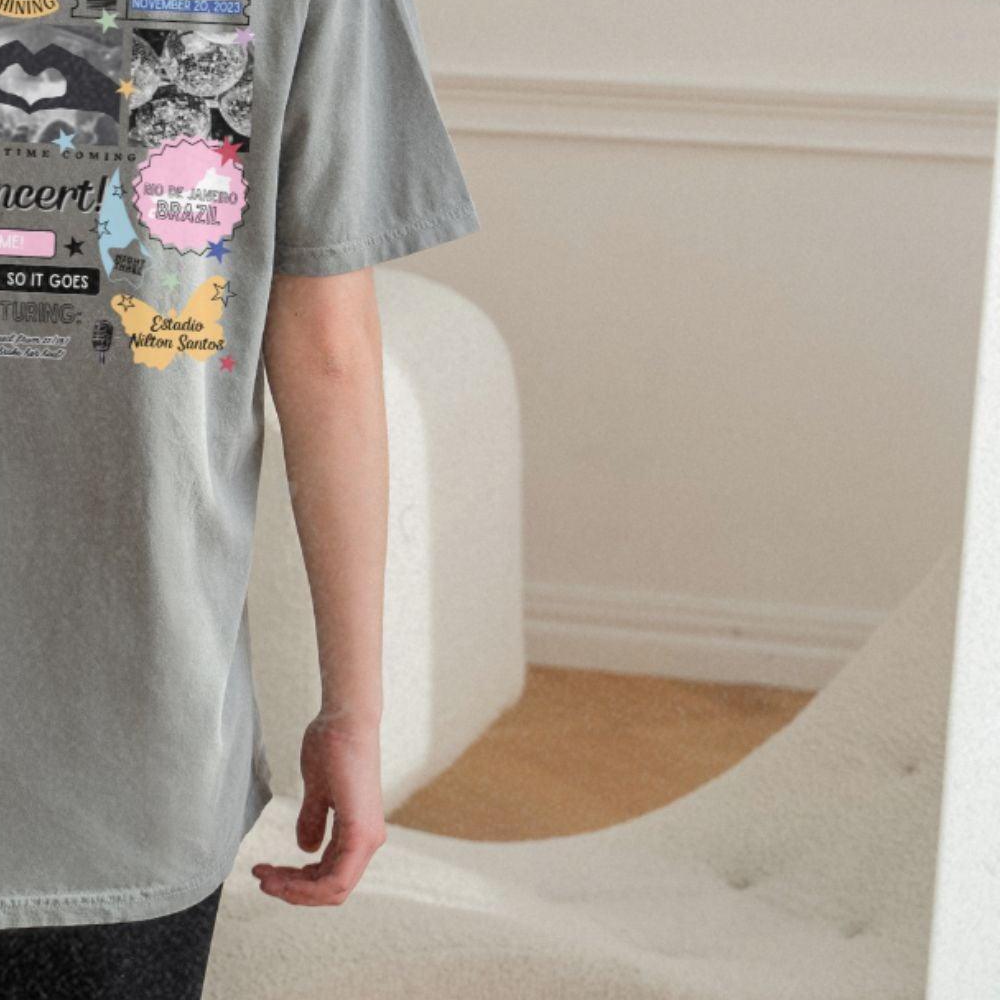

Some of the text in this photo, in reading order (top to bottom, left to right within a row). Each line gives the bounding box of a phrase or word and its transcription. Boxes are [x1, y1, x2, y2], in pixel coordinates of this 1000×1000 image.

[194, 1, 211, 13] 20,
[214, 1, 240, 13] 2023
[4, 148, 50, 158] TIME
[61, 150, 137, 162] COMING
[143, 182, 239, 205] RIO DE JANEIRO
[155, 199, 221, 225] BRAZIL
[6, 271, 89, 290] SO IT GOES
[150, 315, 205, 333] Estadio
[128, 332, 226, 352] Nilton Santos
